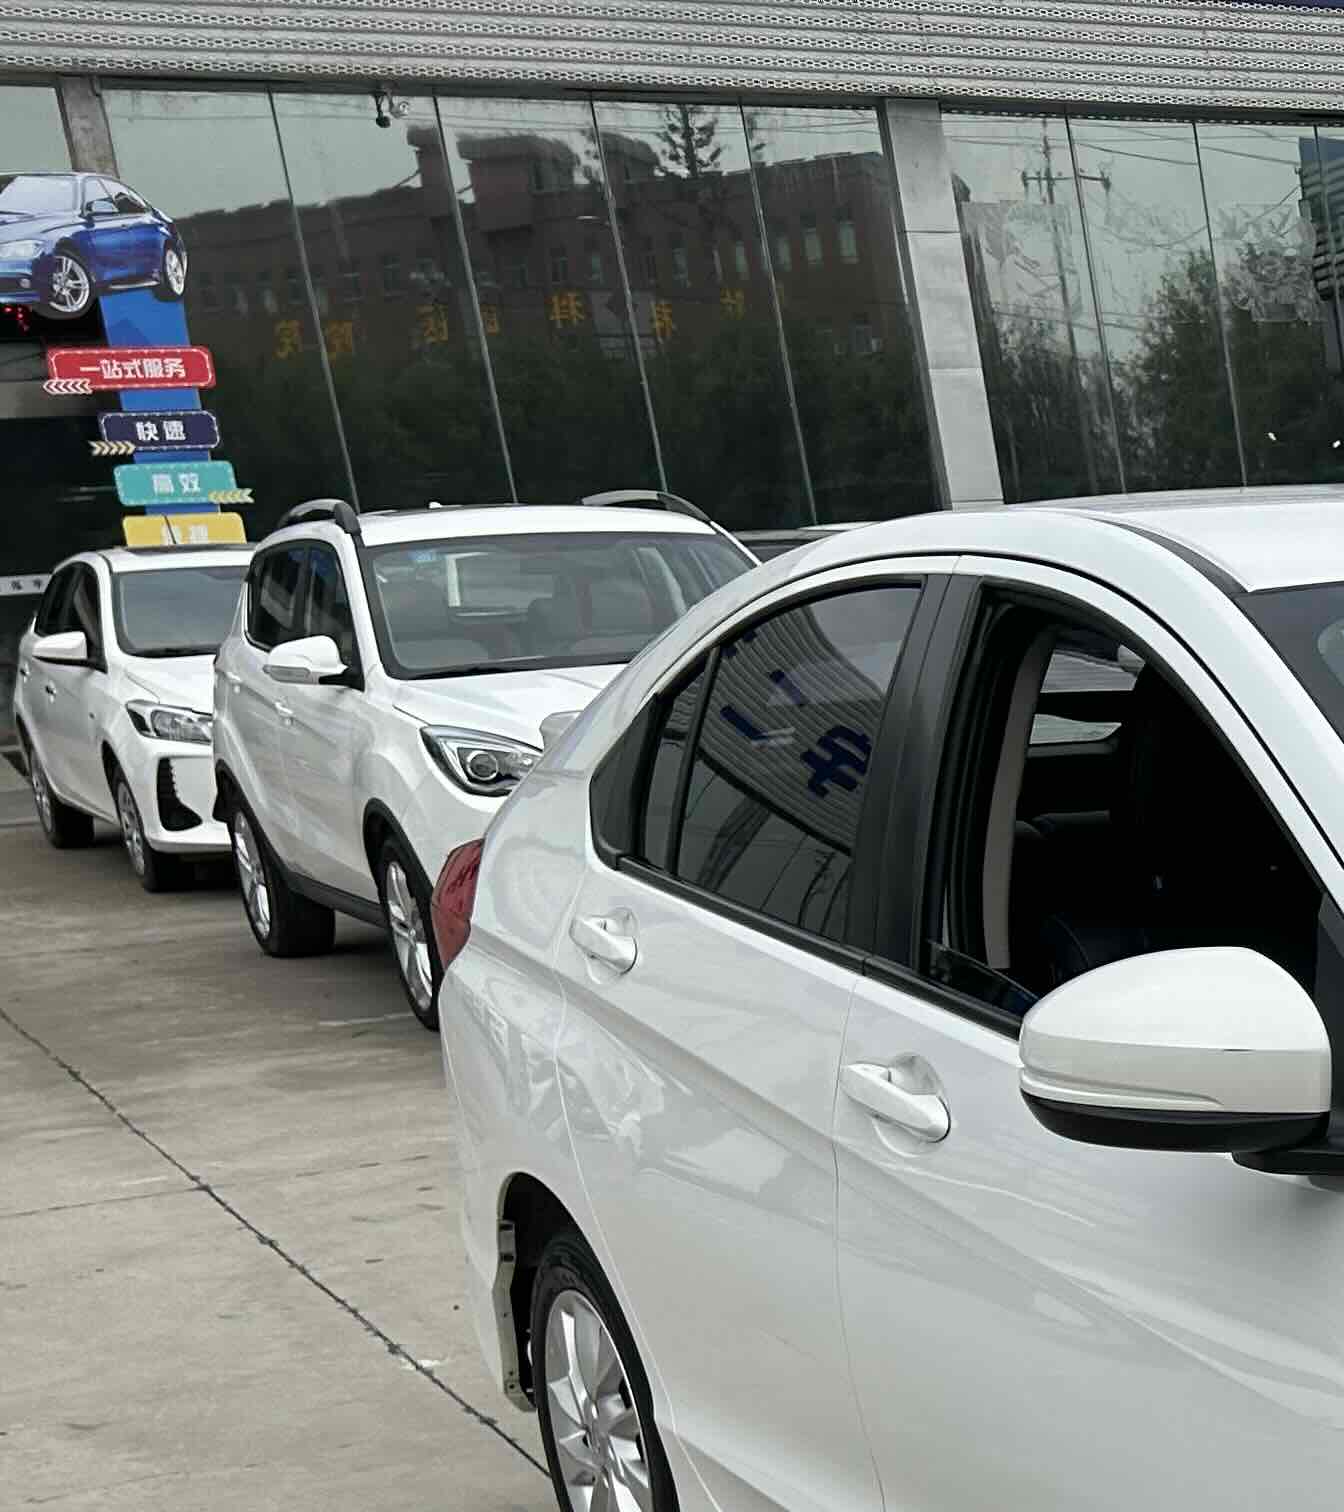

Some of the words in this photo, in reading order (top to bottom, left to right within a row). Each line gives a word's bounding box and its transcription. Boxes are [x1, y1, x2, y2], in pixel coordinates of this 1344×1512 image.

[80, 358, 187, 380] 一站式服务
[135, 420, 187, 441] 快速
